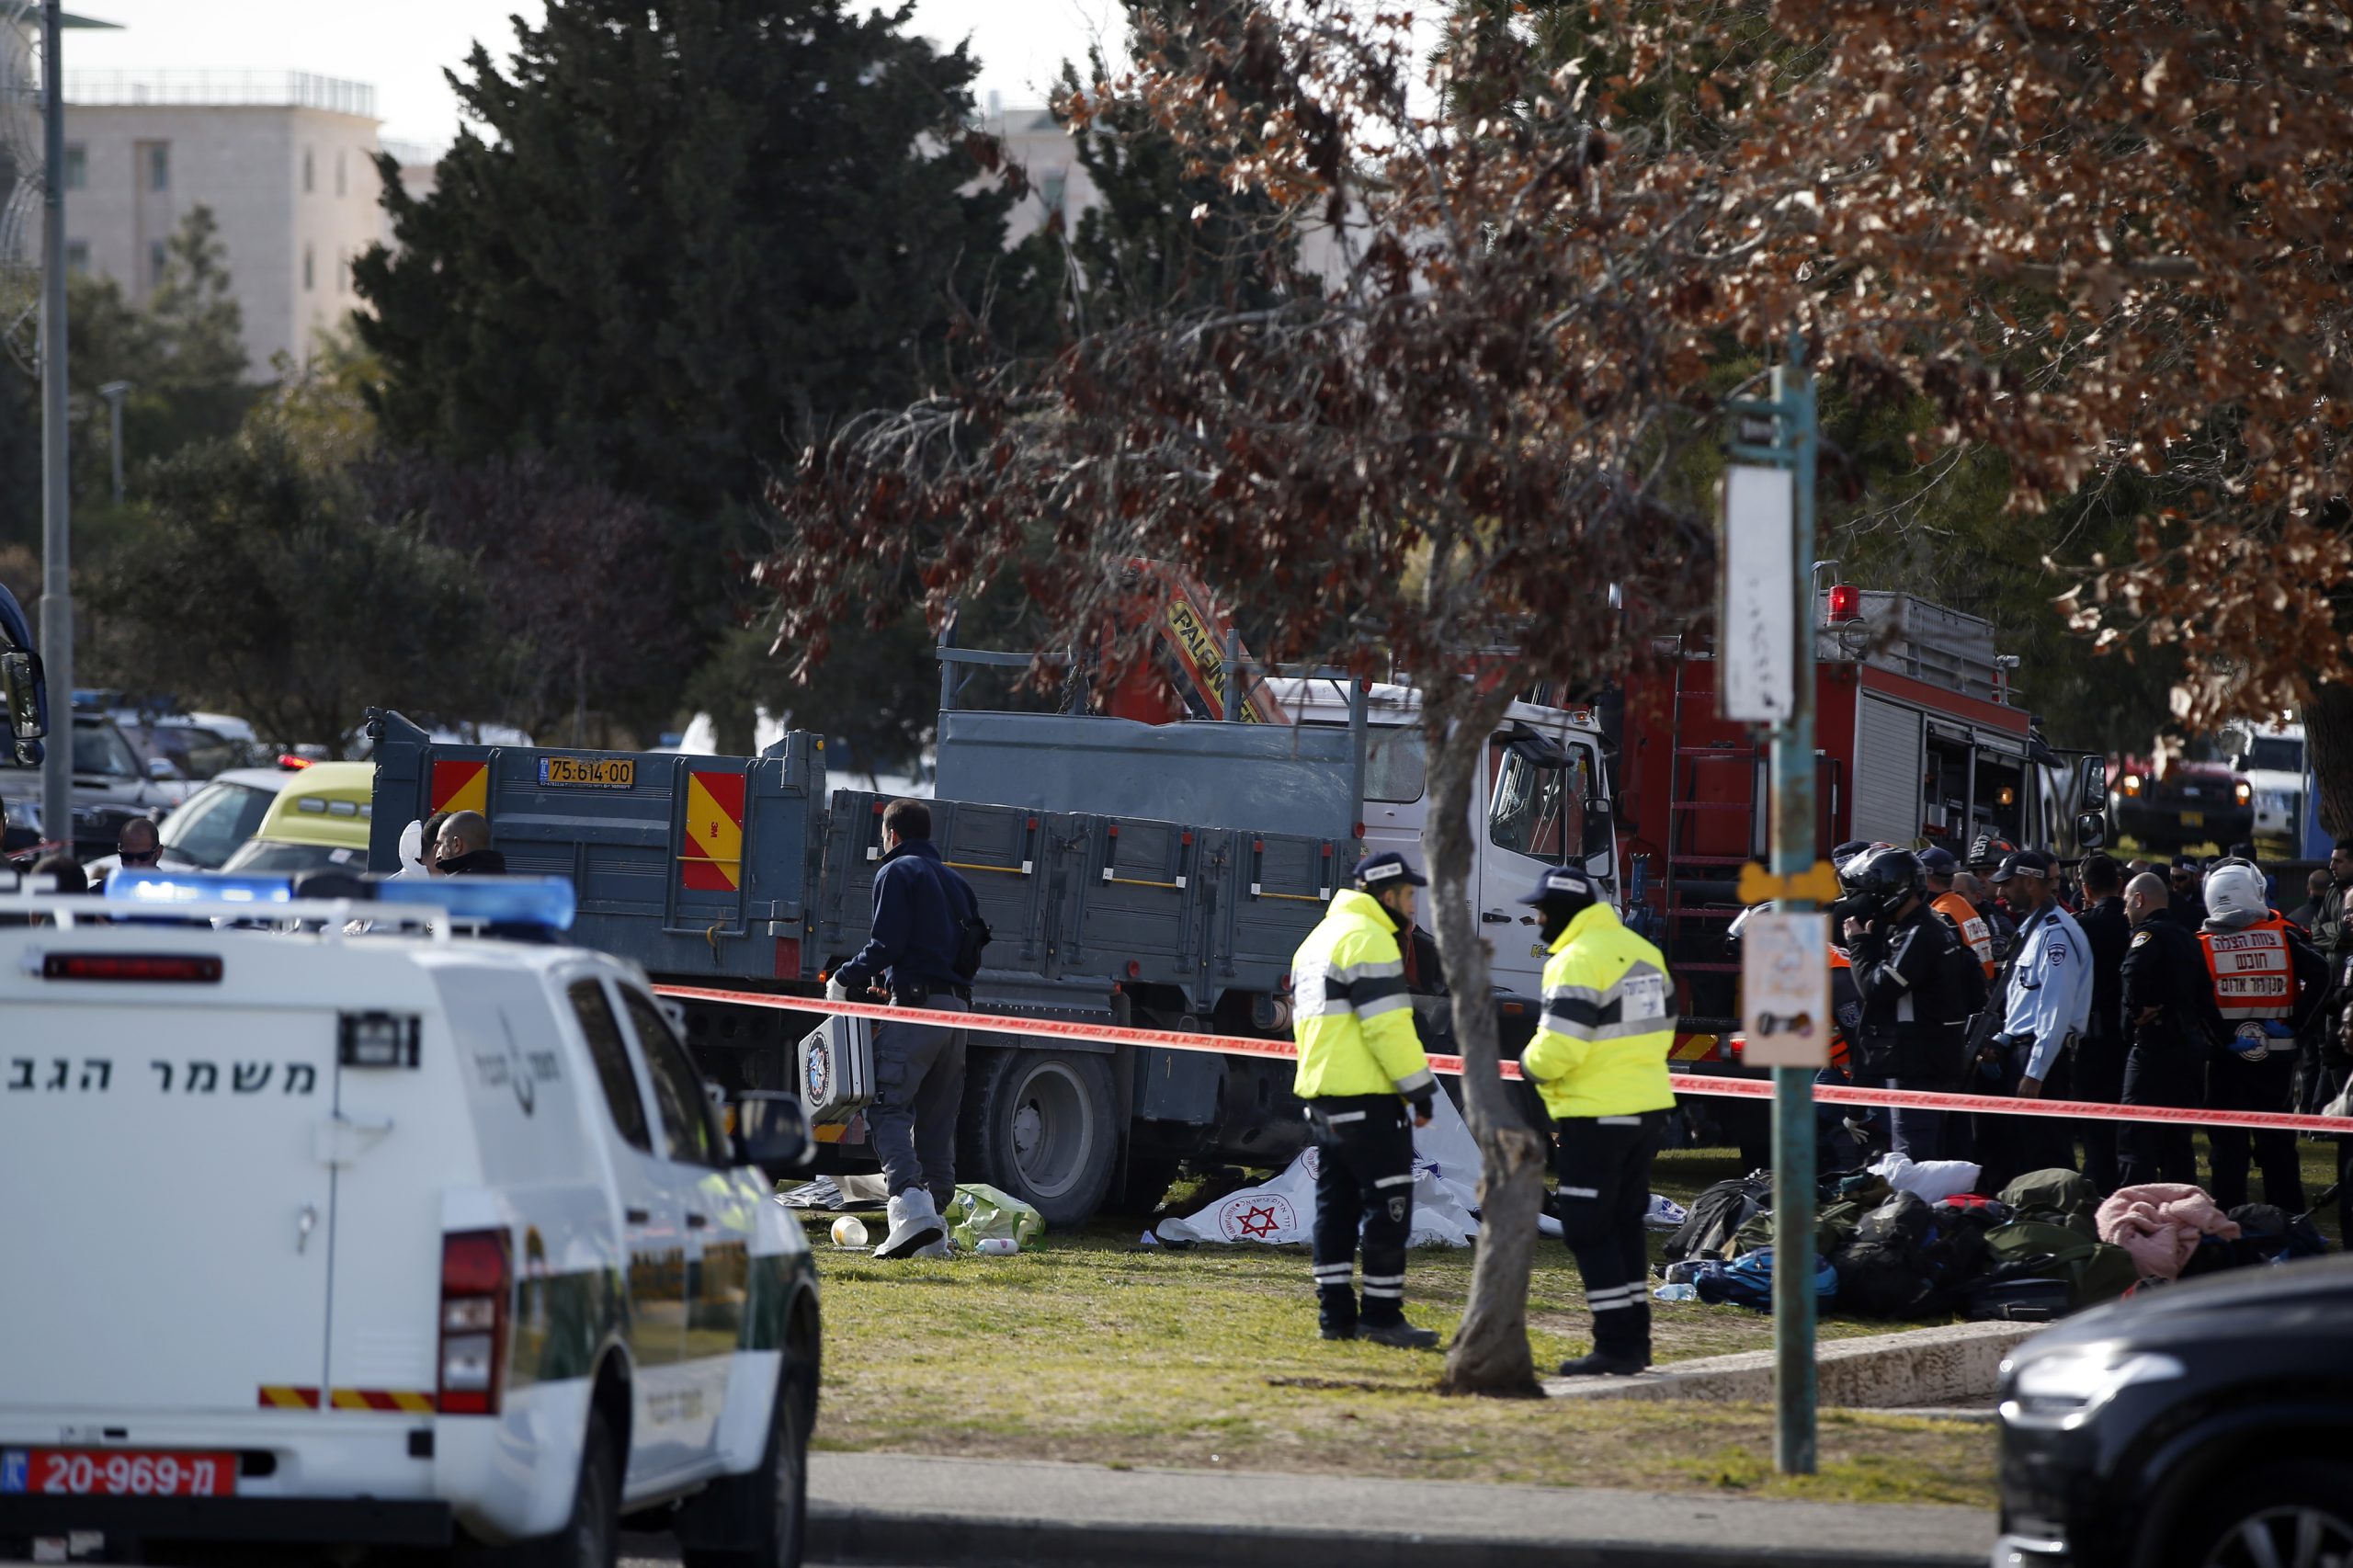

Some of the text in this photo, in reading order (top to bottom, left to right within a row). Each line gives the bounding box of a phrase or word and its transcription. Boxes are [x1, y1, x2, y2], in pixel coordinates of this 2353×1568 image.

[1173, 608, 1256, 723] PALFIN
[710, 822, 719, 837] 3M
[1972, 841, 1987, 853] 25
[2214, 933, 2278, 950] צוות הצלה
[2235, 952, 2268, 970] חובש
[2221, 977, 2246, 993] אדום
[2250, 977, 2267, 993] דוד
[151, 1060, 317, 1095] משמר
[1271, 1198, 1288, 1214] אדום
